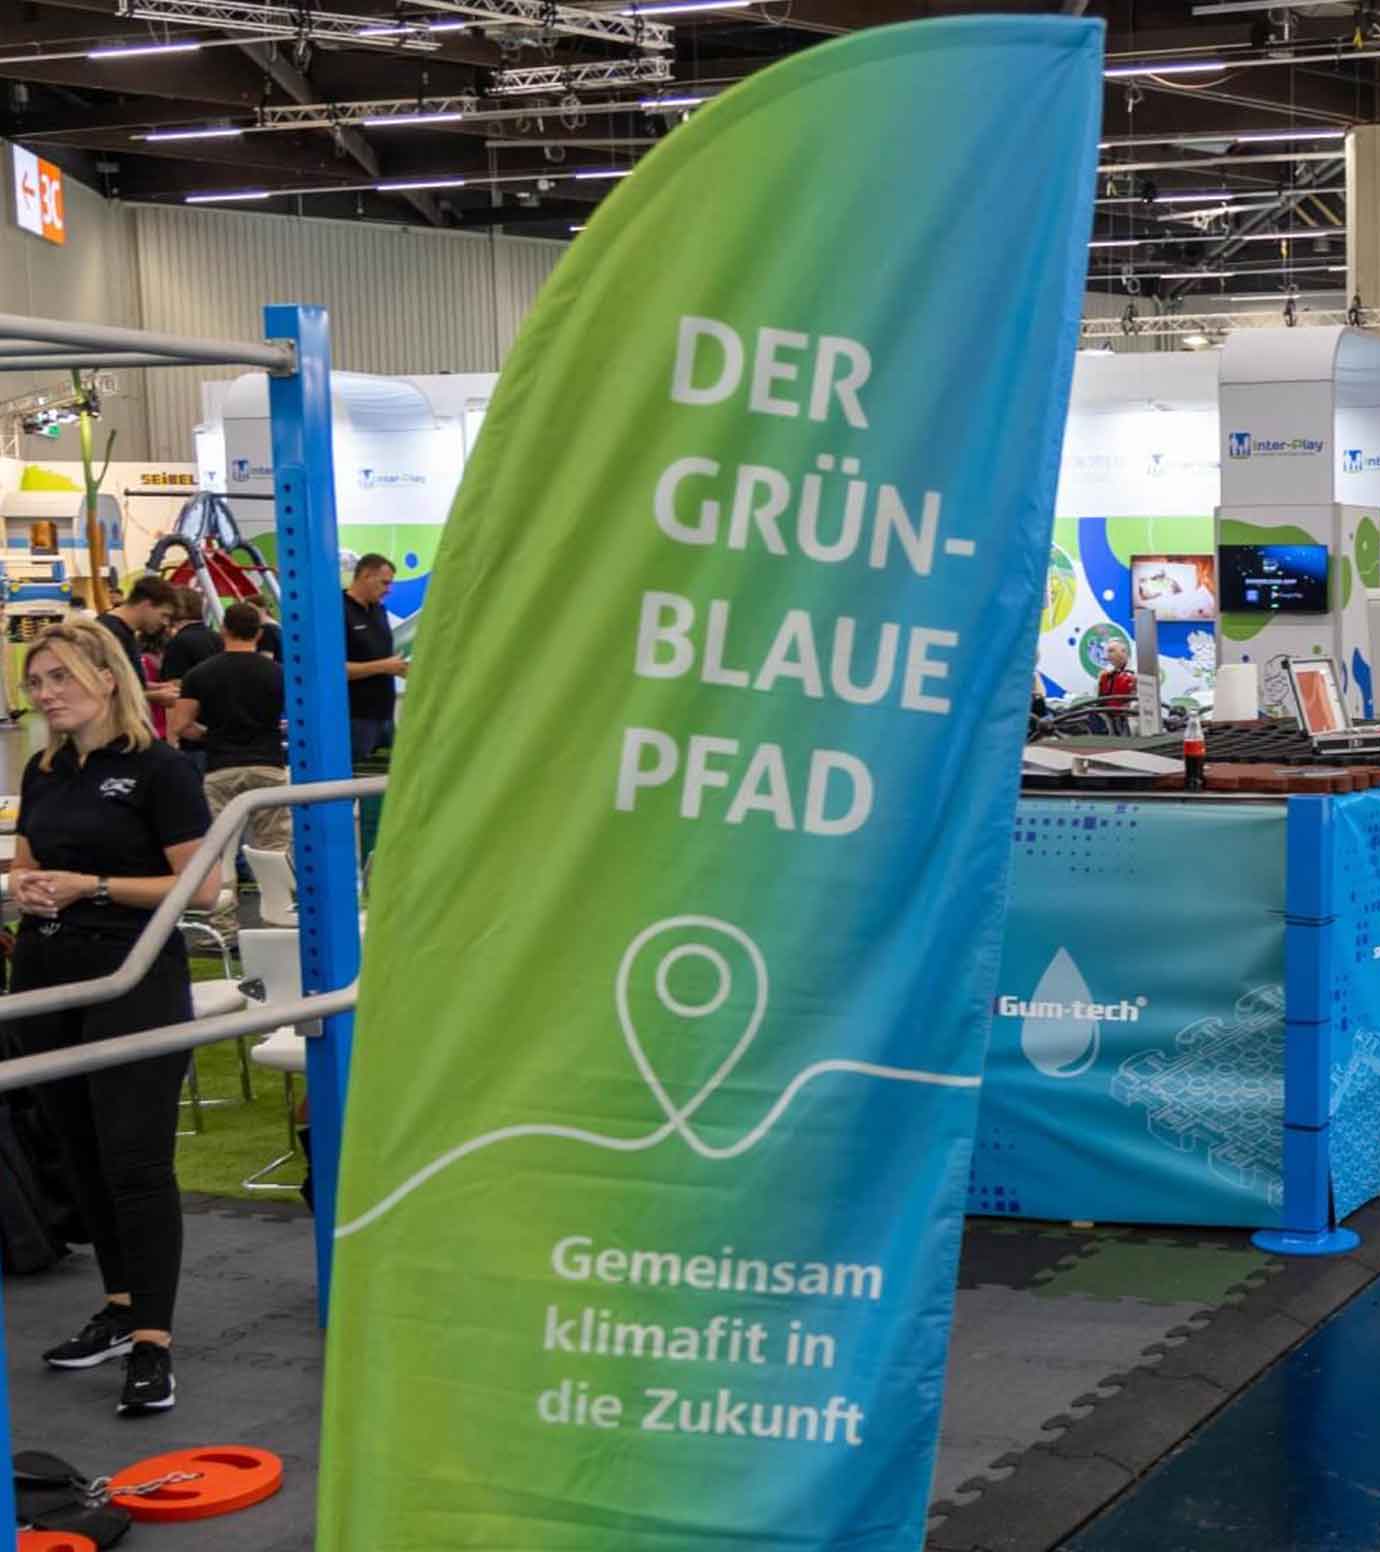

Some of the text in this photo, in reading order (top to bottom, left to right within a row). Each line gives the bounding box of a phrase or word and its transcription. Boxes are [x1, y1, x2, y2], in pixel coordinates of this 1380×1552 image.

[670, 314, 873, 430] DER
[653, 452, 976, 577] GRÜN-
[634, 590, 960, 715] BLAUE
[615, 726, 876, 837] PFAD
[551, 1235, 883, 1299] Gemeinsam
[543, 1306, 836, 1368] klimafit in
[537, 1380, 864, 1446] die Zukunft
